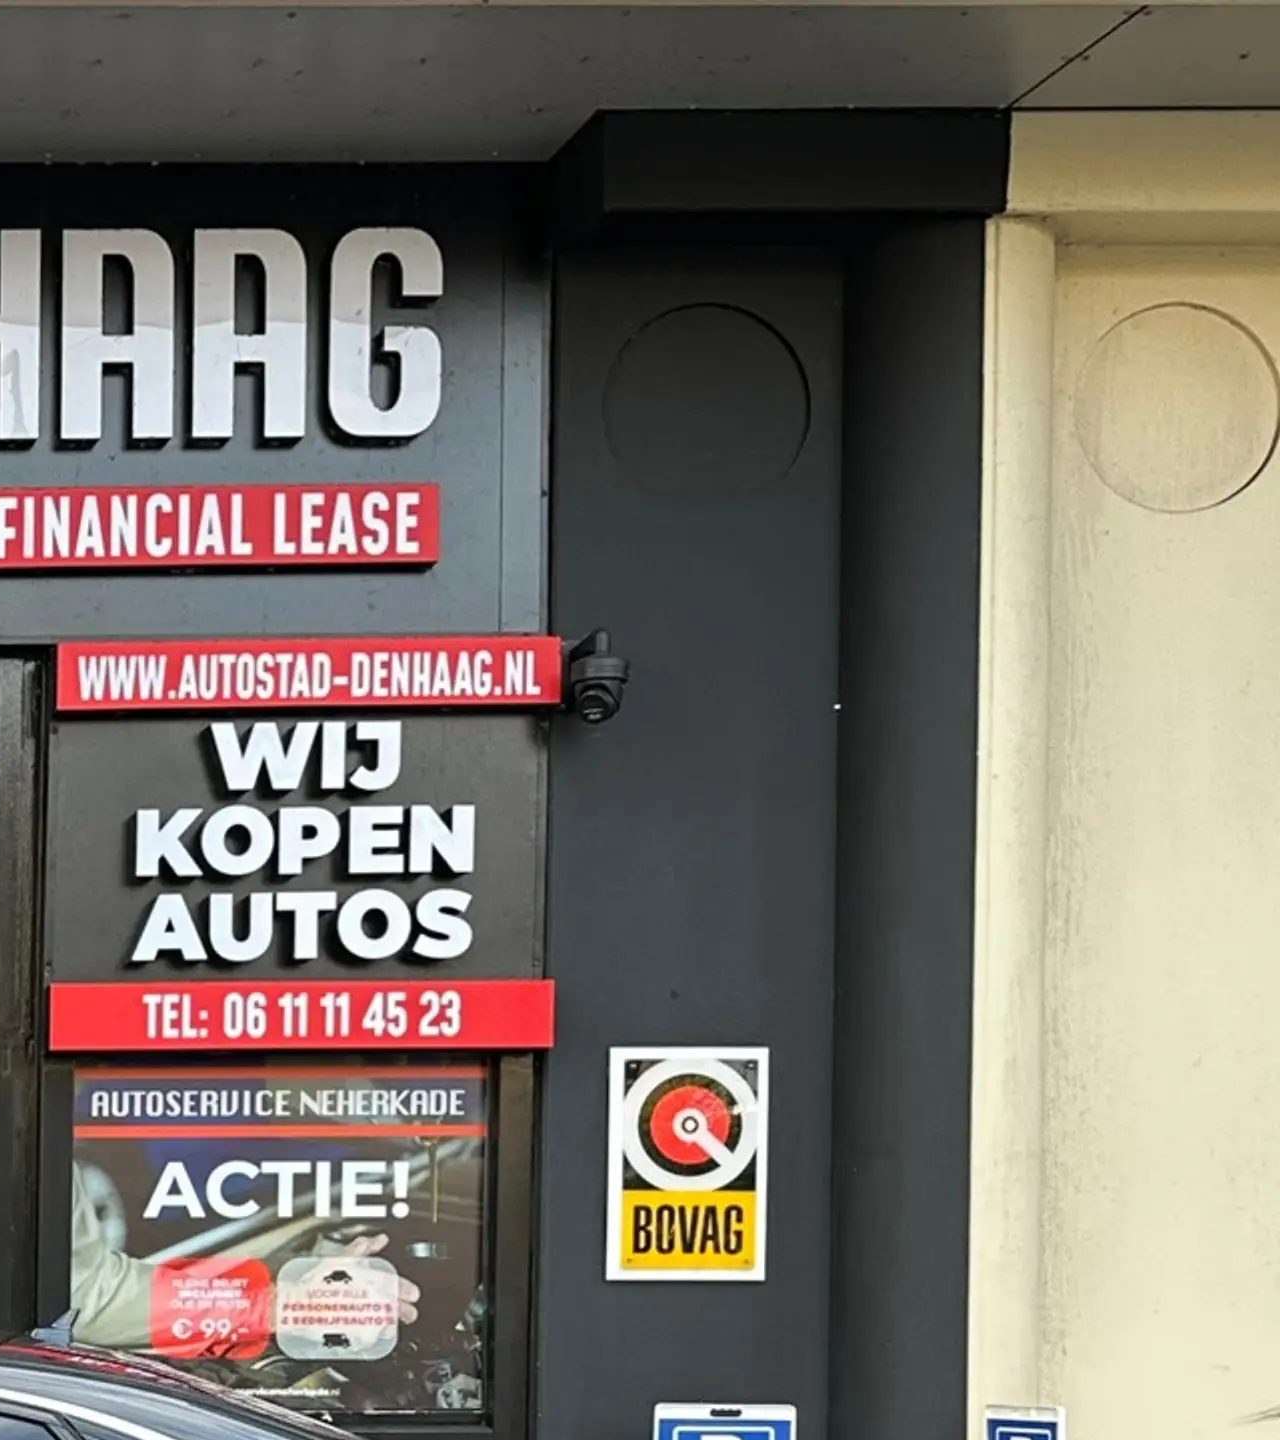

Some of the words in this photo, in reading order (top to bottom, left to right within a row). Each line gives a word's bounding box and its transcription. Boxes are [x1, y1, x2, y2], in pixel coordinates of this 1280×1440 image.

[272, 491, 420, 555] LEASE
[77, 649, 541, 701] WWW.AUTOSTAD-DENHAAG.NL
[211, 720, 402, 792] WIJ
[134, 804, 475, 877] KOPEN
[131, 889, 473, 962] AUTOS
[143, 993, 209, 1039] TEL:
[223, 992, 265, 1038] 06
[277, 991, 307, 1037] 11
[321, 991, 351, 1036] 11
[363, 991, 406, 1037] 45
[419, 991, 461, 1036] 23
[91, 1089, 290, 1117] AUTOSERVICE
[299, 1090, 466, 1117] NEHERKADE
[143, 1160, 410, 1220] ACTIE!
[632, 1204, 744, 1255] BOVAG
[171, 1317, 194, 1340] €
[200, 1317, 251, 1342] 99,-
[282, 1302, 394, 1313] PERSONENAUTO'S
[293, 1315, 395, 1326] BEDRIJFSAUTO'S
